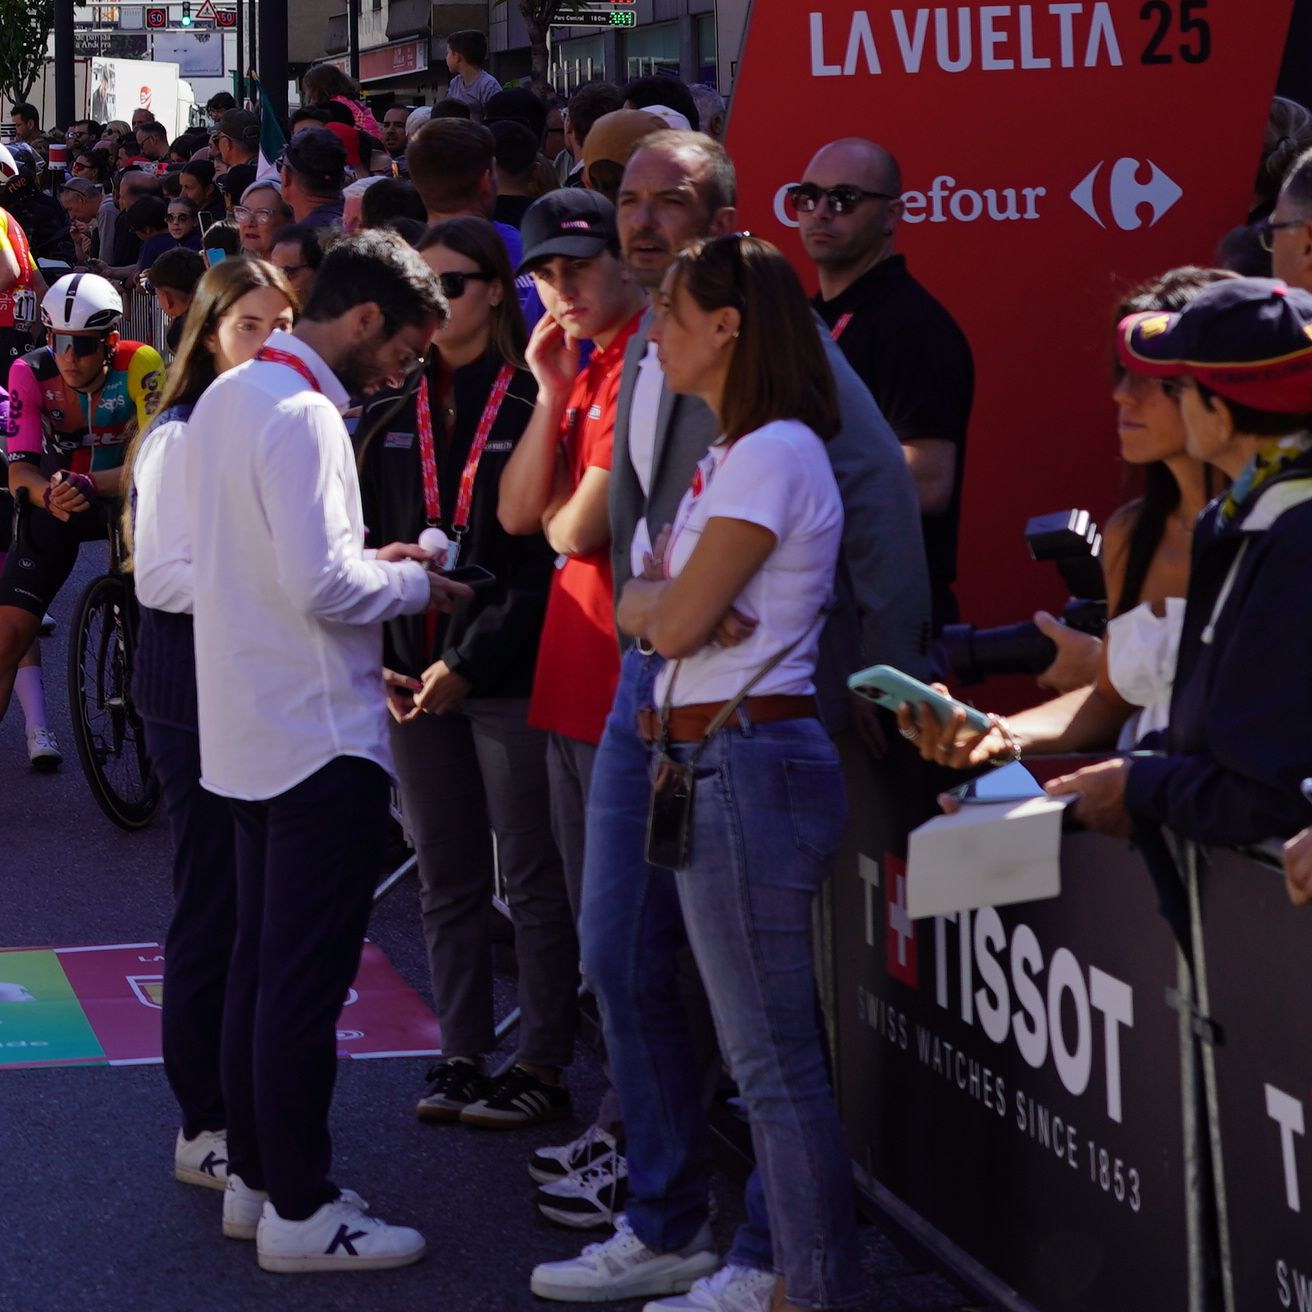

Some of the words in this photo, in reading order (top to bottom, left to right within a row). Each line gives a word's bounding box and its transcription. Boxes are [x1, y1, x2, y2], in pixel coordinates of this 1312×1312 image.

[151, 13, 161, 22] 50
[810, 11, 881, 76] LA
[892, 3, 1122, 72] VUELTA
[857, 984, 909, 1052] SWISS
[915, 1024, 1008, 1119] WATCHES
[1015, 1089, 1079, 1171] SINCE
[1087, 1141, 1142, 1214] 1853
[324, 1224, 368, 1256] K
